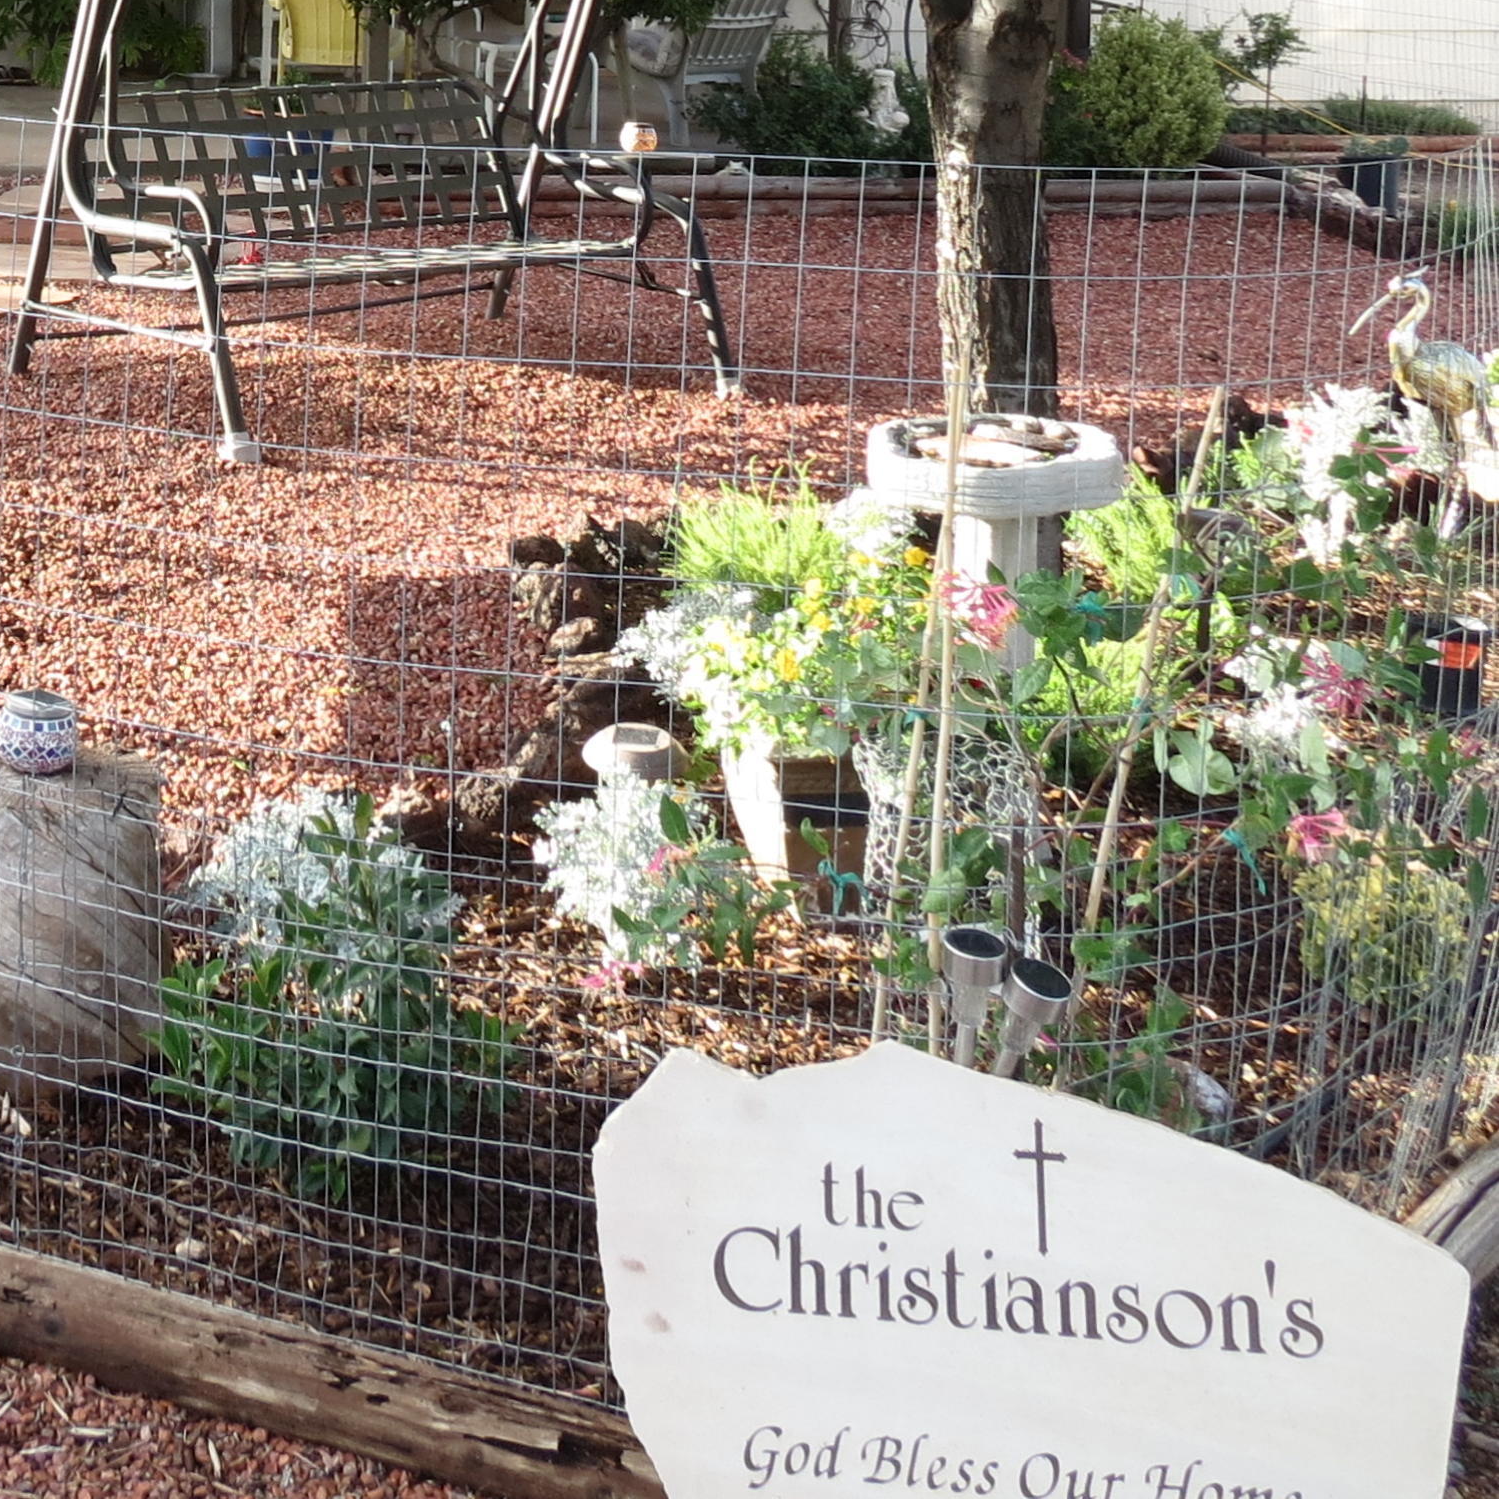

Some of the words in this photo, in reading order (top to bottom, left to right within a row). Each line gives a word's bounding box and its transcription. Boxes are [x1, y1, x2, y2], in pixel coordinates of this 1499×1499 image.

[821, 1161, 925, 1231] the
[713, 1224, 1324, 1359] Christianson's
[743, 1425, 851, 1489] God
[861, 1434, 999, 1495] Bless
[1019, 1452, 1125, 1499] Our
[1145, 1459, 1302, 1499] Ho
